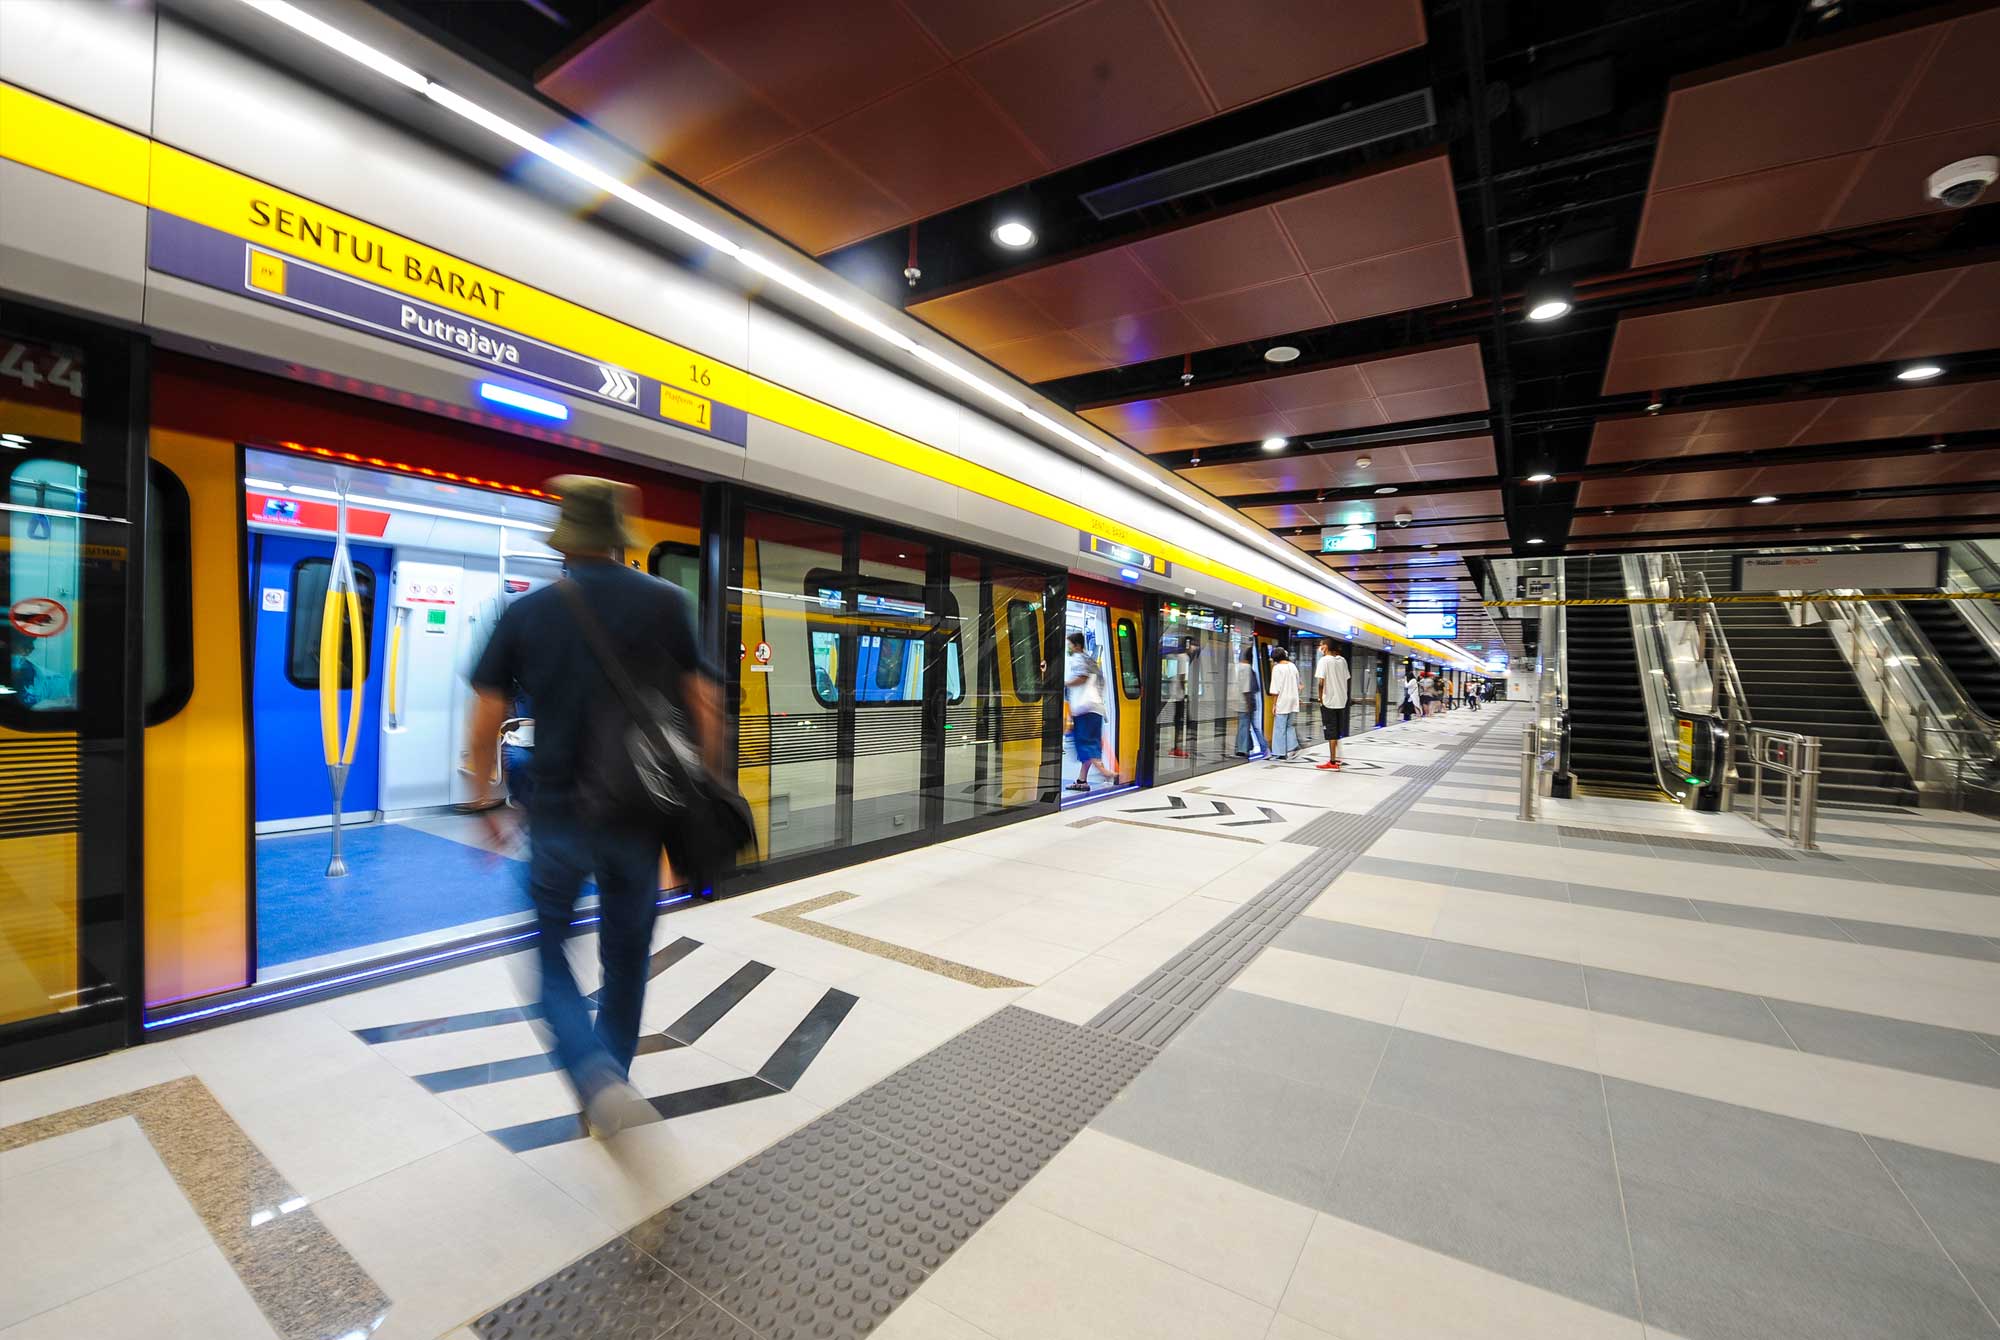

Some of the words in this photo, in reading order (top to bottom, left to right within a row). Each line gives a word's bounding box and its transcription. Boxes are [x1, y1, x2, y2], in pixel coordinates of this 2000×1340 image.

[248, 199, 393, 273] SENTUL
[403, 254, 506, 311] BARAT
[400, 303, 520, 364] Putrajaya
[689, 365, 711, 386] 16
[696, 402, 707, 425] 1
